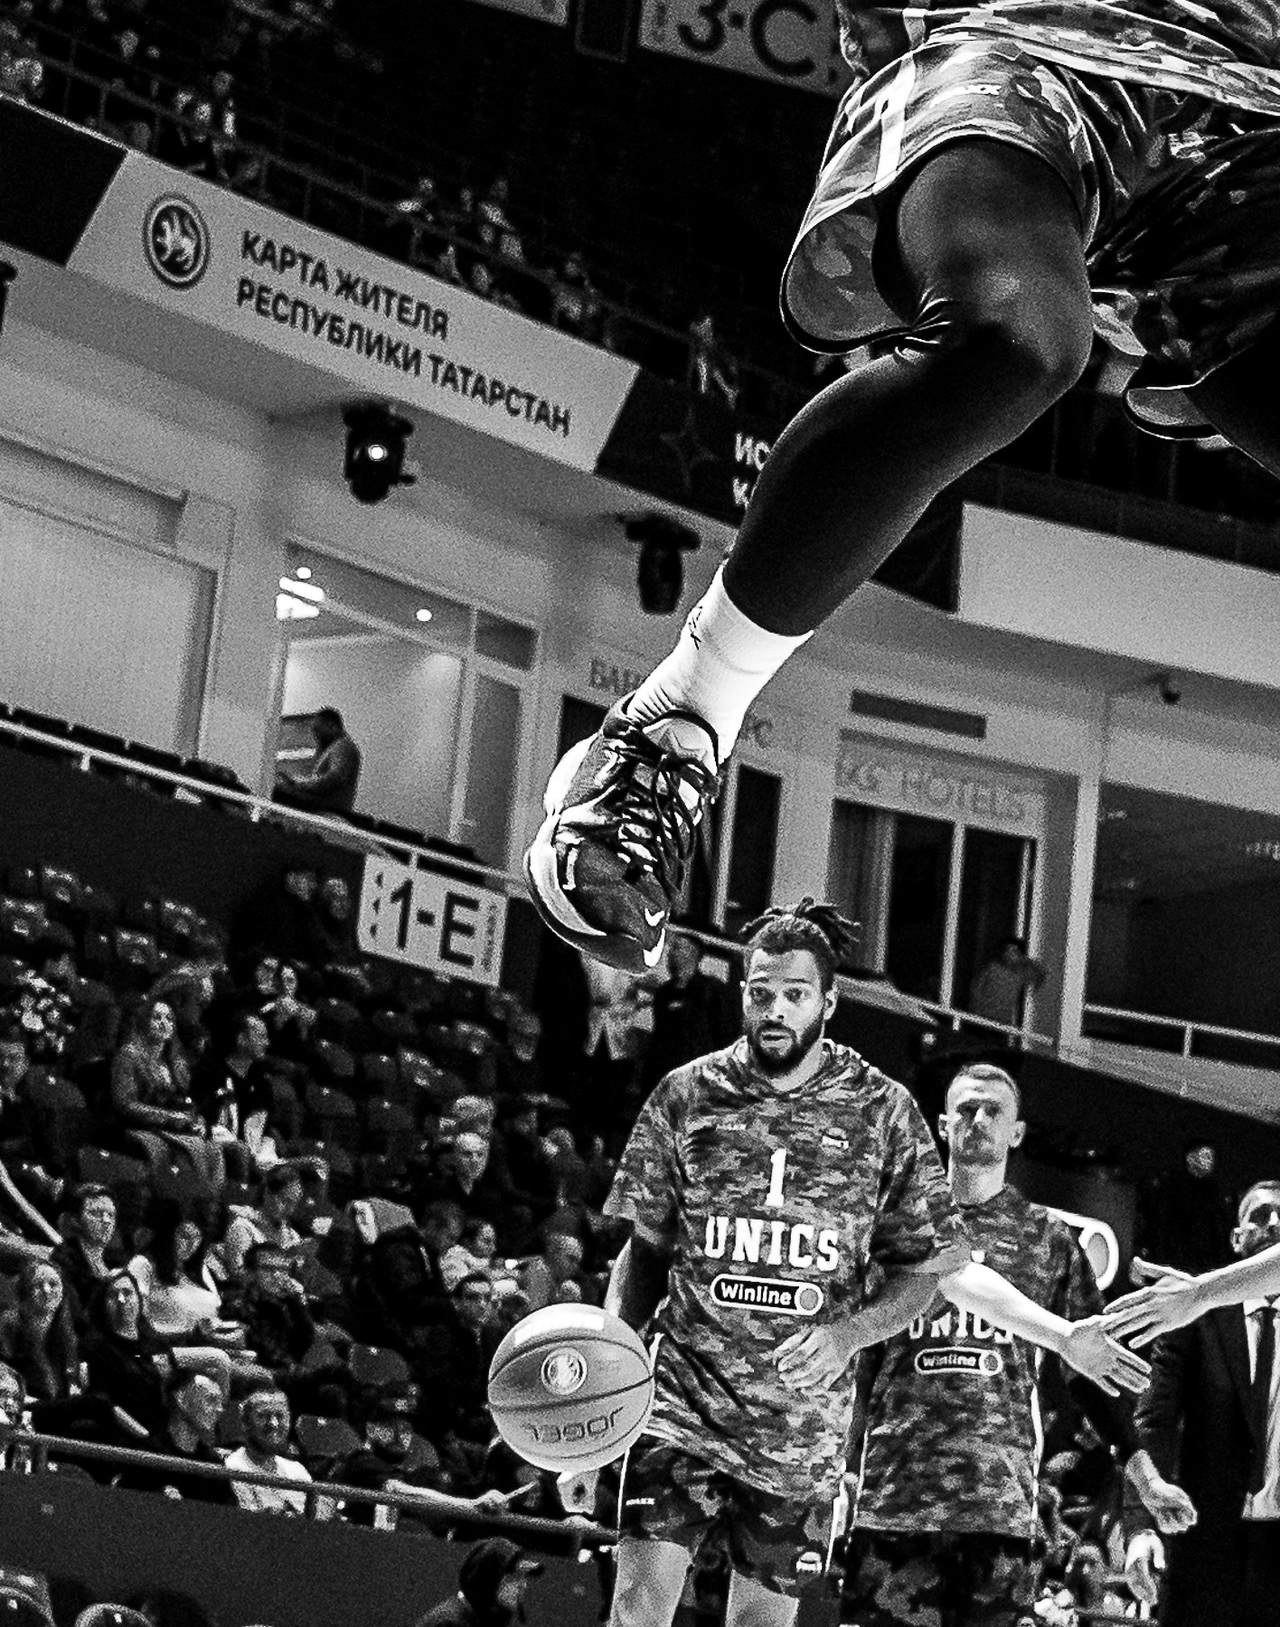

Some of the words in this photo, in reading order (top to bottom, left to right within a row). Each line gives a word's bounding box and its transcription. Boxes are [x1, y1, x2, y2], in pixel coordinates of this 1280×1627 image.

[241, 230, 330, 293] КАРТА
[333, 267, 450, 341] ЖИТЕЛЯ
[236, 276, 421, 376] РЕСПУБЛИКИ
[426, 353, 572, 438] ТАТАРСТАН
[389, 877, 482, 969] 1-E
[765, 1147, 788, 1208] 1
[704, 1215, 840, 1272] UNICS
[721, 1281, 793, 1306] Winline
